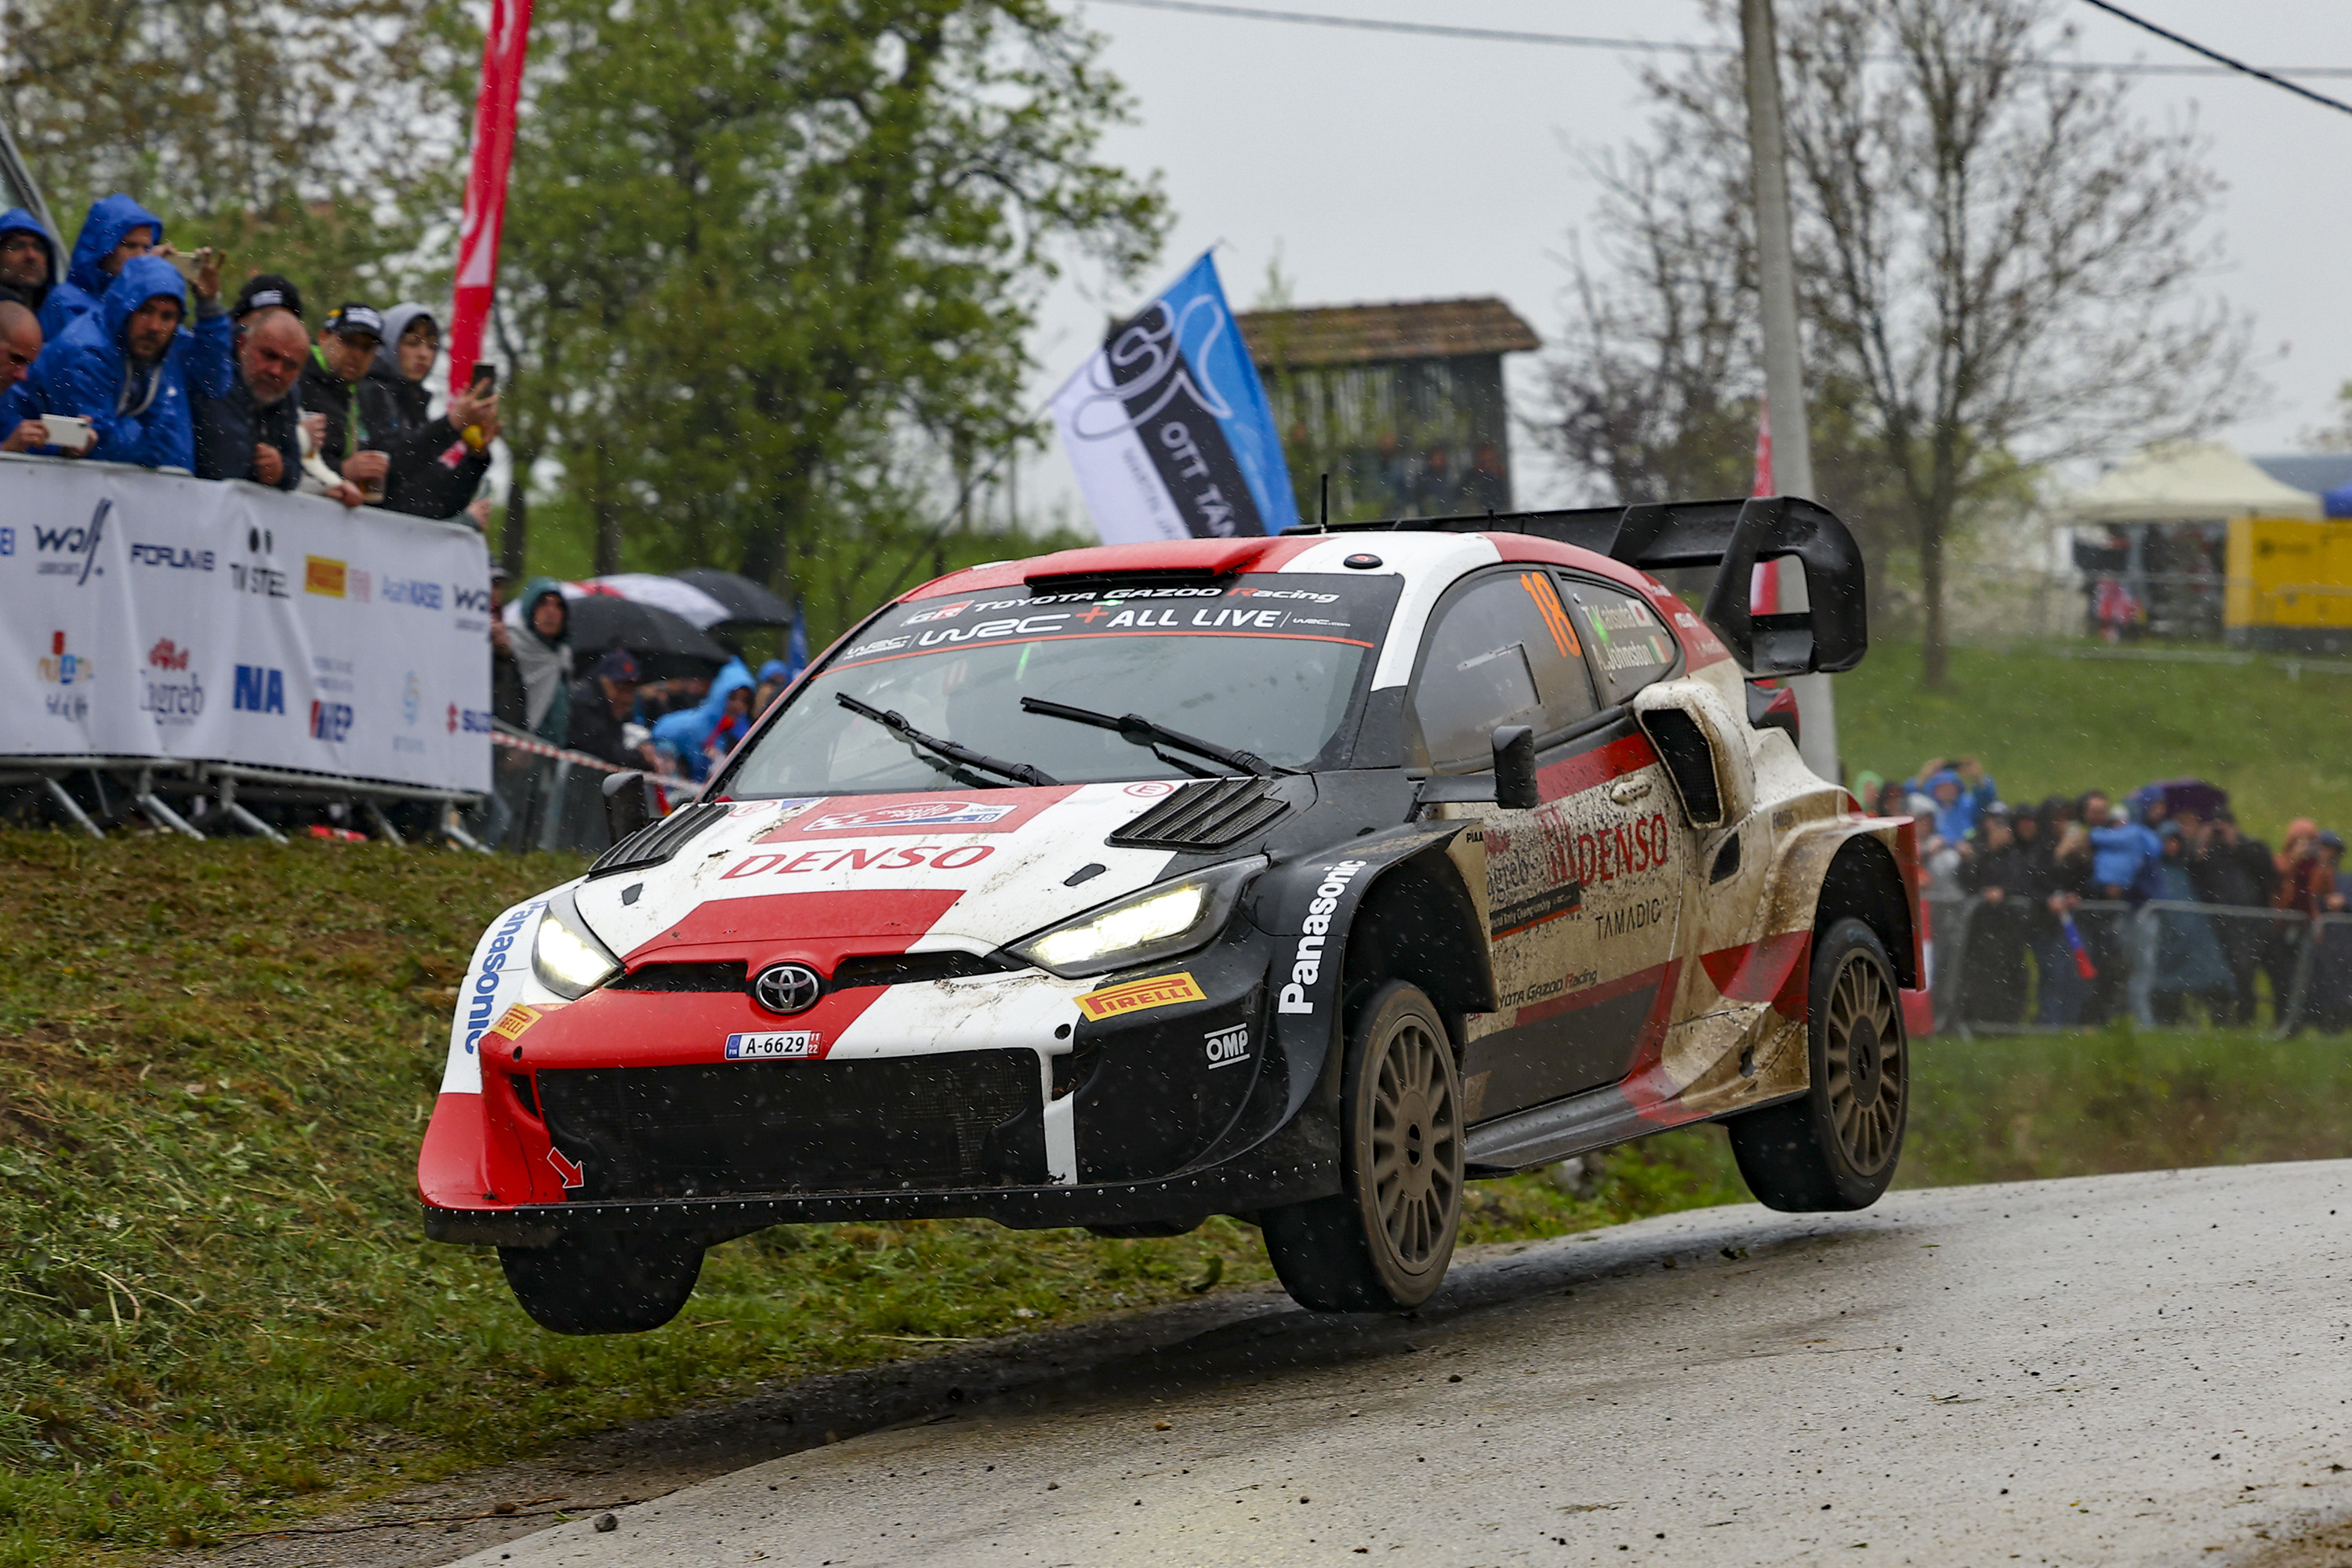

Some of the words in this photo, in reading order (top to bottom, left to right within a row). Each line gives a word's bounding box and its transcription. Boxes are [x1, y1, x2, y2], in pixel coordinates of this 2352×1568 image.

[1160, 420, 1208, 480] OTT
[974, 592, 1097, 613] TOYOTA
[1102, 588, 1223, 600] GAZOO
[1226, 587, 1340, 603] Racing
[1105, 608, 1179, 628] ALL
[1191, 609, 1283, 628] LIVE
[1519, 571, 1582, 658] 18
[1466, 831, 1484, 844] PIAA
[1578, 813, 1668, 887] DENSO
[718, 845, 996, 880] DENSO
[1487, 848, 1529, 903] agreb
[1278, 859, 1368, 1014] Panasonic
[1595, 898, 1661, 940] TAMADIC
[466, 900, 549, 1054] Panasonic
[1498, 990, 1525, 1008] YOTA
[1527, 978, 1563, 1000] GAZOO
[1564, 970, 1598, 990] Racing
[1085, 978, 1193, 1014] PIRELLI
[746, 1036, 804, 1054] A-6629
[808, 1044, 818, 1054] 22
[811, 1033, 820, 1041] 11
[1206, 1030, 1249, 1062] OMP
